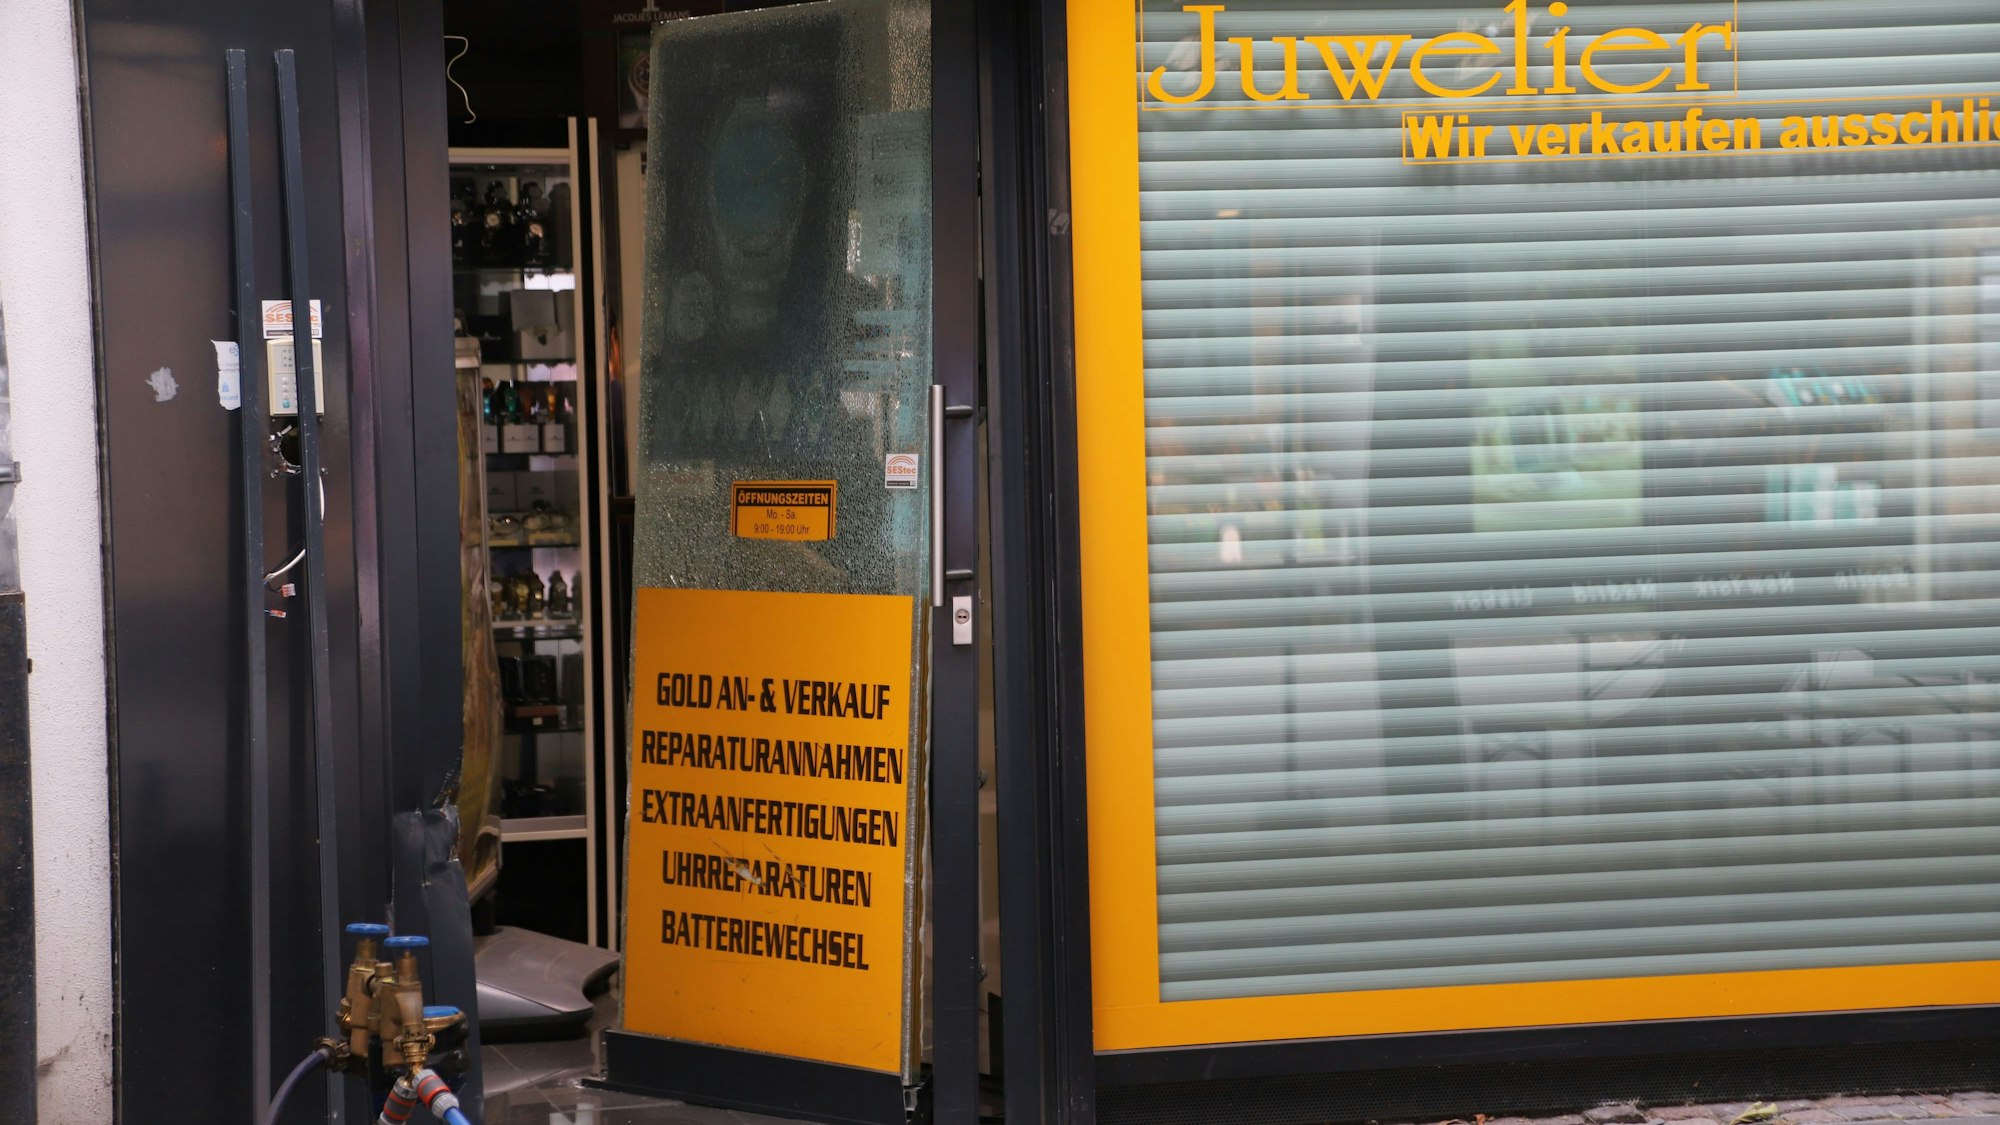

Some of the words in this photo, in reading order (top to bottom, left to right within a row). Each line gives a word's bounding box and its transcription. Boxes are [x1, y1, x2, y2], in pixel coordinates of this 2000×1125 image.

[612, 13, 652, 23] JACQUES
[1147, 0, 1732, 104] Juwelier
[1407, 115, 1493, 159] Wir
[1509, 107, 1762, 157] verkaufen
[1779, 97, 2000, 149] ausschli
[265, 312, 319, 323] SESc
[886, 465, 916, 475] SEStec
[738, 490, 829, 505] ÖFFNUNGSZEITEN
[753, 523, 770, 534] 9:00
[796, 525, 810, 535] Uhr
[657, 672, 712, 708] GOLD
[717, 676, 755, 711] AN-
[760, 678, 777, 713] &
[783, 679, 890, 720] VERKAUF
[641, 730, 903, 784] REPARATURANNAHMEN
[641, 789, 898, 847] EXTRAANFERTIGUNGEN
[662, 850, 871, 908] UHRREPARATUREN
[661, 909, 869, 970] BATTERIEWECHSEL
